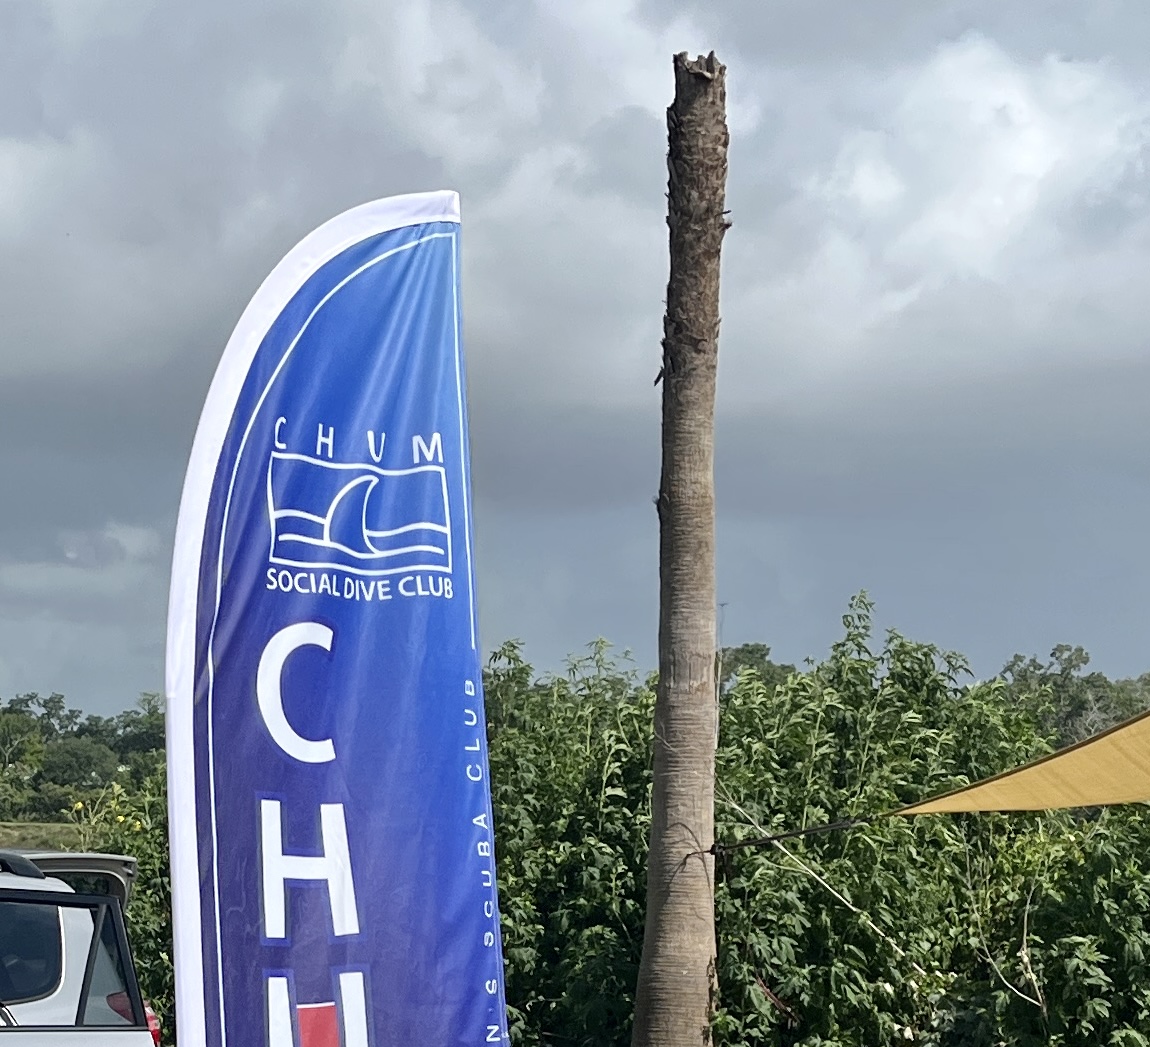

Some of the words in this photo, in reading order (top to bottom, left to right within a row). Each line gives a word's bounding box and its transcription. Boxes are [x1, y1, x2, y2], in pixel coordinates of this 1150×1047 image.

[273, 416, 444, 465] CHUM
[266, 567, 341, 597] SOCIAL
[343, 577, 393, 601] DIVE
[398, 575, 453, 600] CLUB
[464, 679, 482, 782] CLUB
[472, 813, 494, 947] SCUBA
